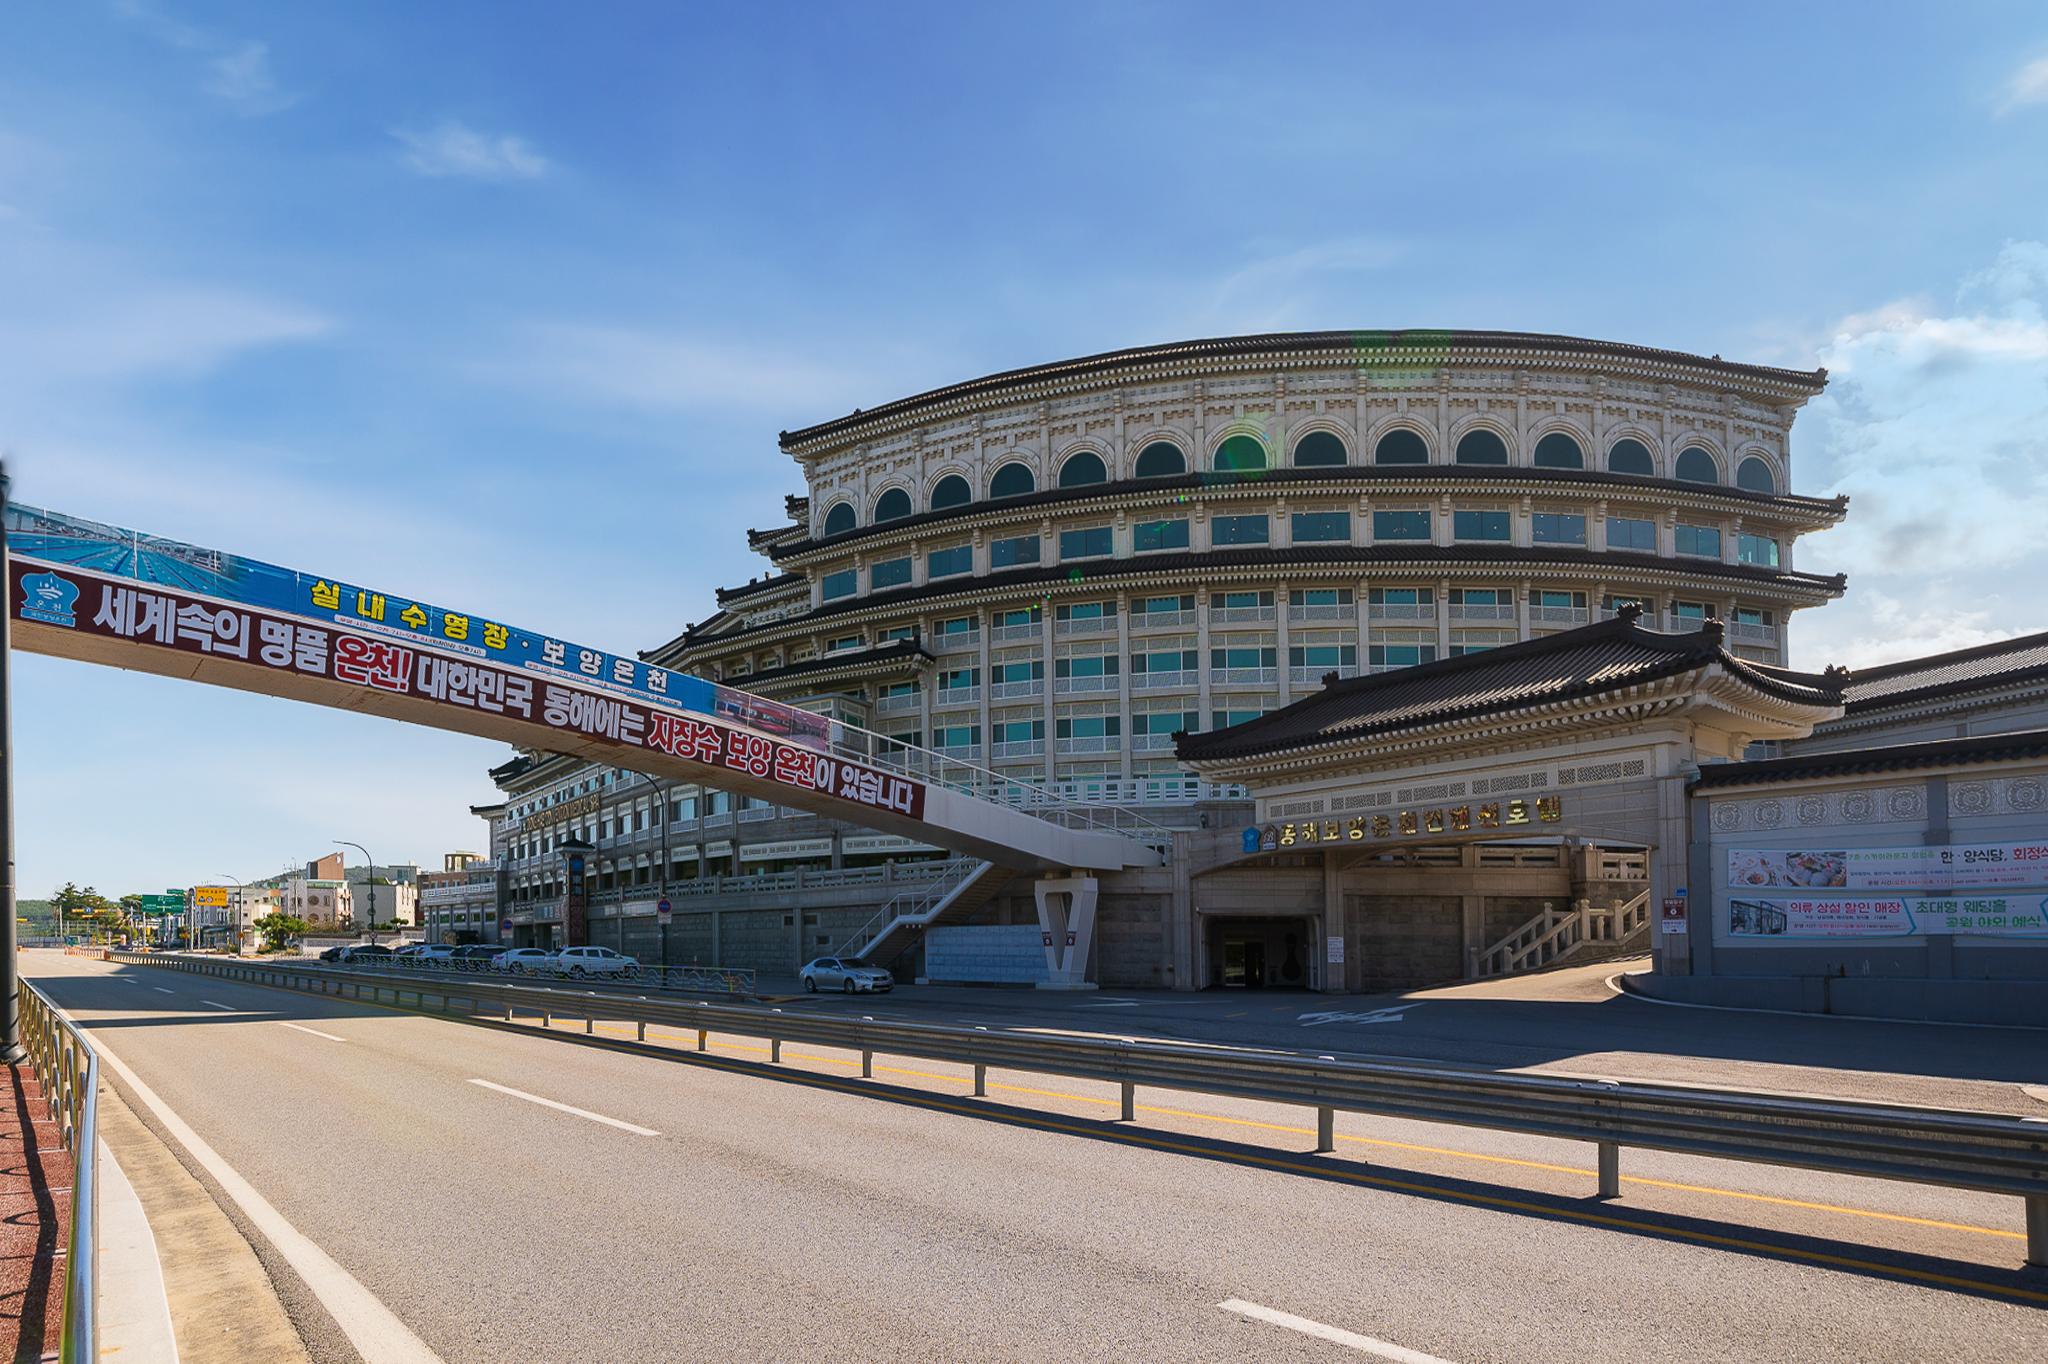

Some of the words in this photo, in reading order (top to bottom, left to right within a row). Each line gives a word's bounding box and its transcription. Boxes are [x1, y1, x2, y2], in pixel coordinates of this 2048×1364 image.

[93, 584, 250, 659] 세계속의
[260, 618, 328, 674] 명품
[334, 634, 413, 693] 온천!
[417, 655, 533, 718] 대한민국
[543, 685, 645, 745] 동해에는
[648, 712, 722, 763] 지장수
[725, 731, 773, 777] 보양
[774, 745, 835, 794] 온천이
[840, 765, 913, 814] 있습니다
[1790, 902, 1813, 914] 의류
[1817, 902, 1841, 914] 상설
[1845, 902, 1870, 914] 할인
[1875, 902, 1901, 914] 매장
[1915, 901, 1957, 914] 초대형
[1963, 899, 2006, 914] 웨딩홀
[1978, 916, 2006, 928] 야외
[2012, 915, 2041, 928] 예식
